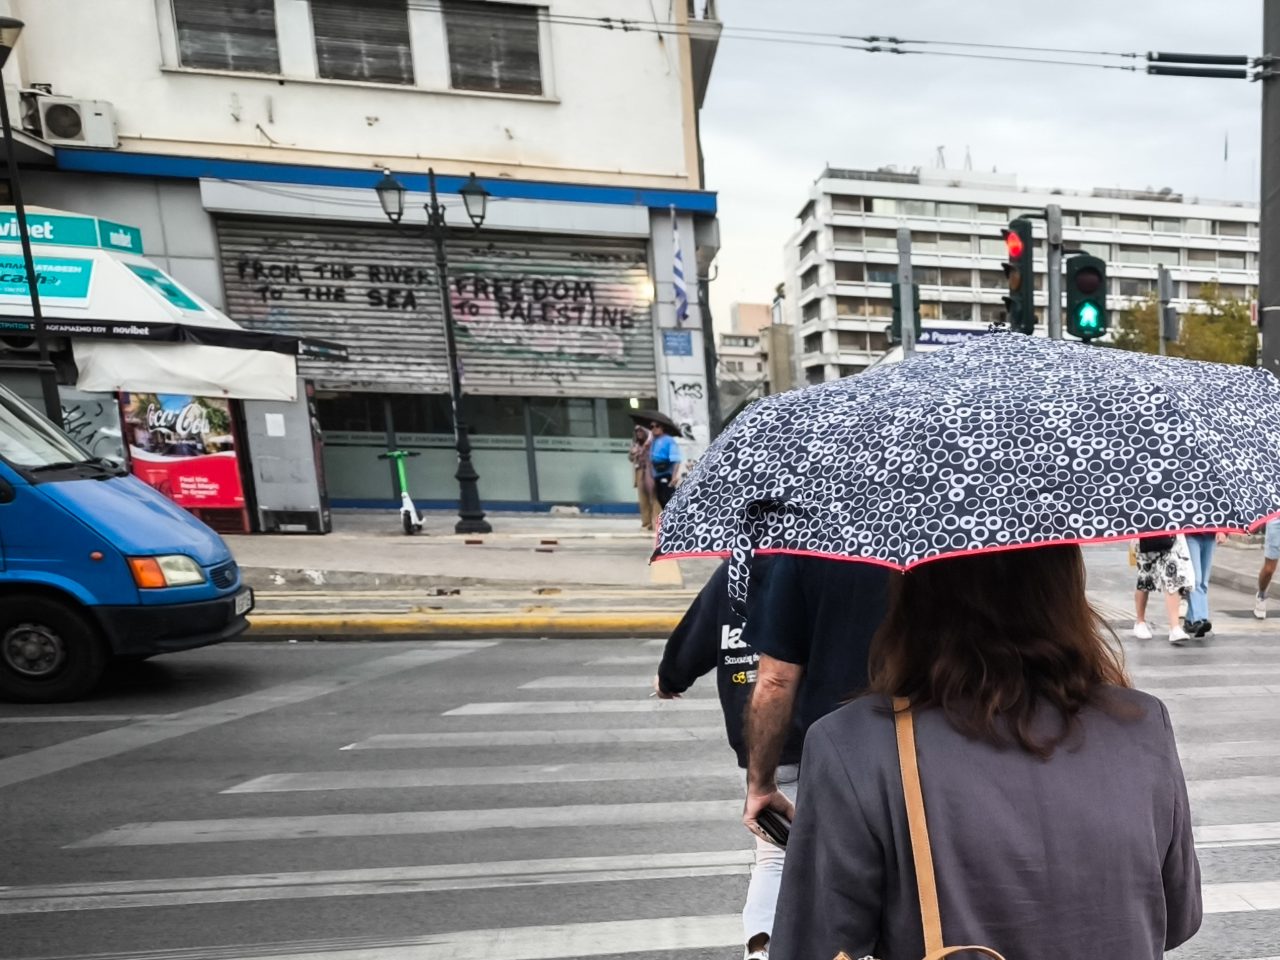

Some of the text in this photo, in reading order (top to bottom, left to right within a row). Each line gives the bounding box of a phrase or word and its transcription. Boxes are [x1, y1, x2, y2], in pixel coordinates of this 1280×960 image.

[238, 259, 434, 285] FROM THE RIVER
[254, 285, 417, 311] TO THE SEA
[455, 277, 595, 304] FREEDOM
[452, 300, 635, 329] TO PALESTINE
[113, 325, 150, 336] novibet
[147, 402, 210, 436] Coca-Cola
[721, 622, 751, 649] la
